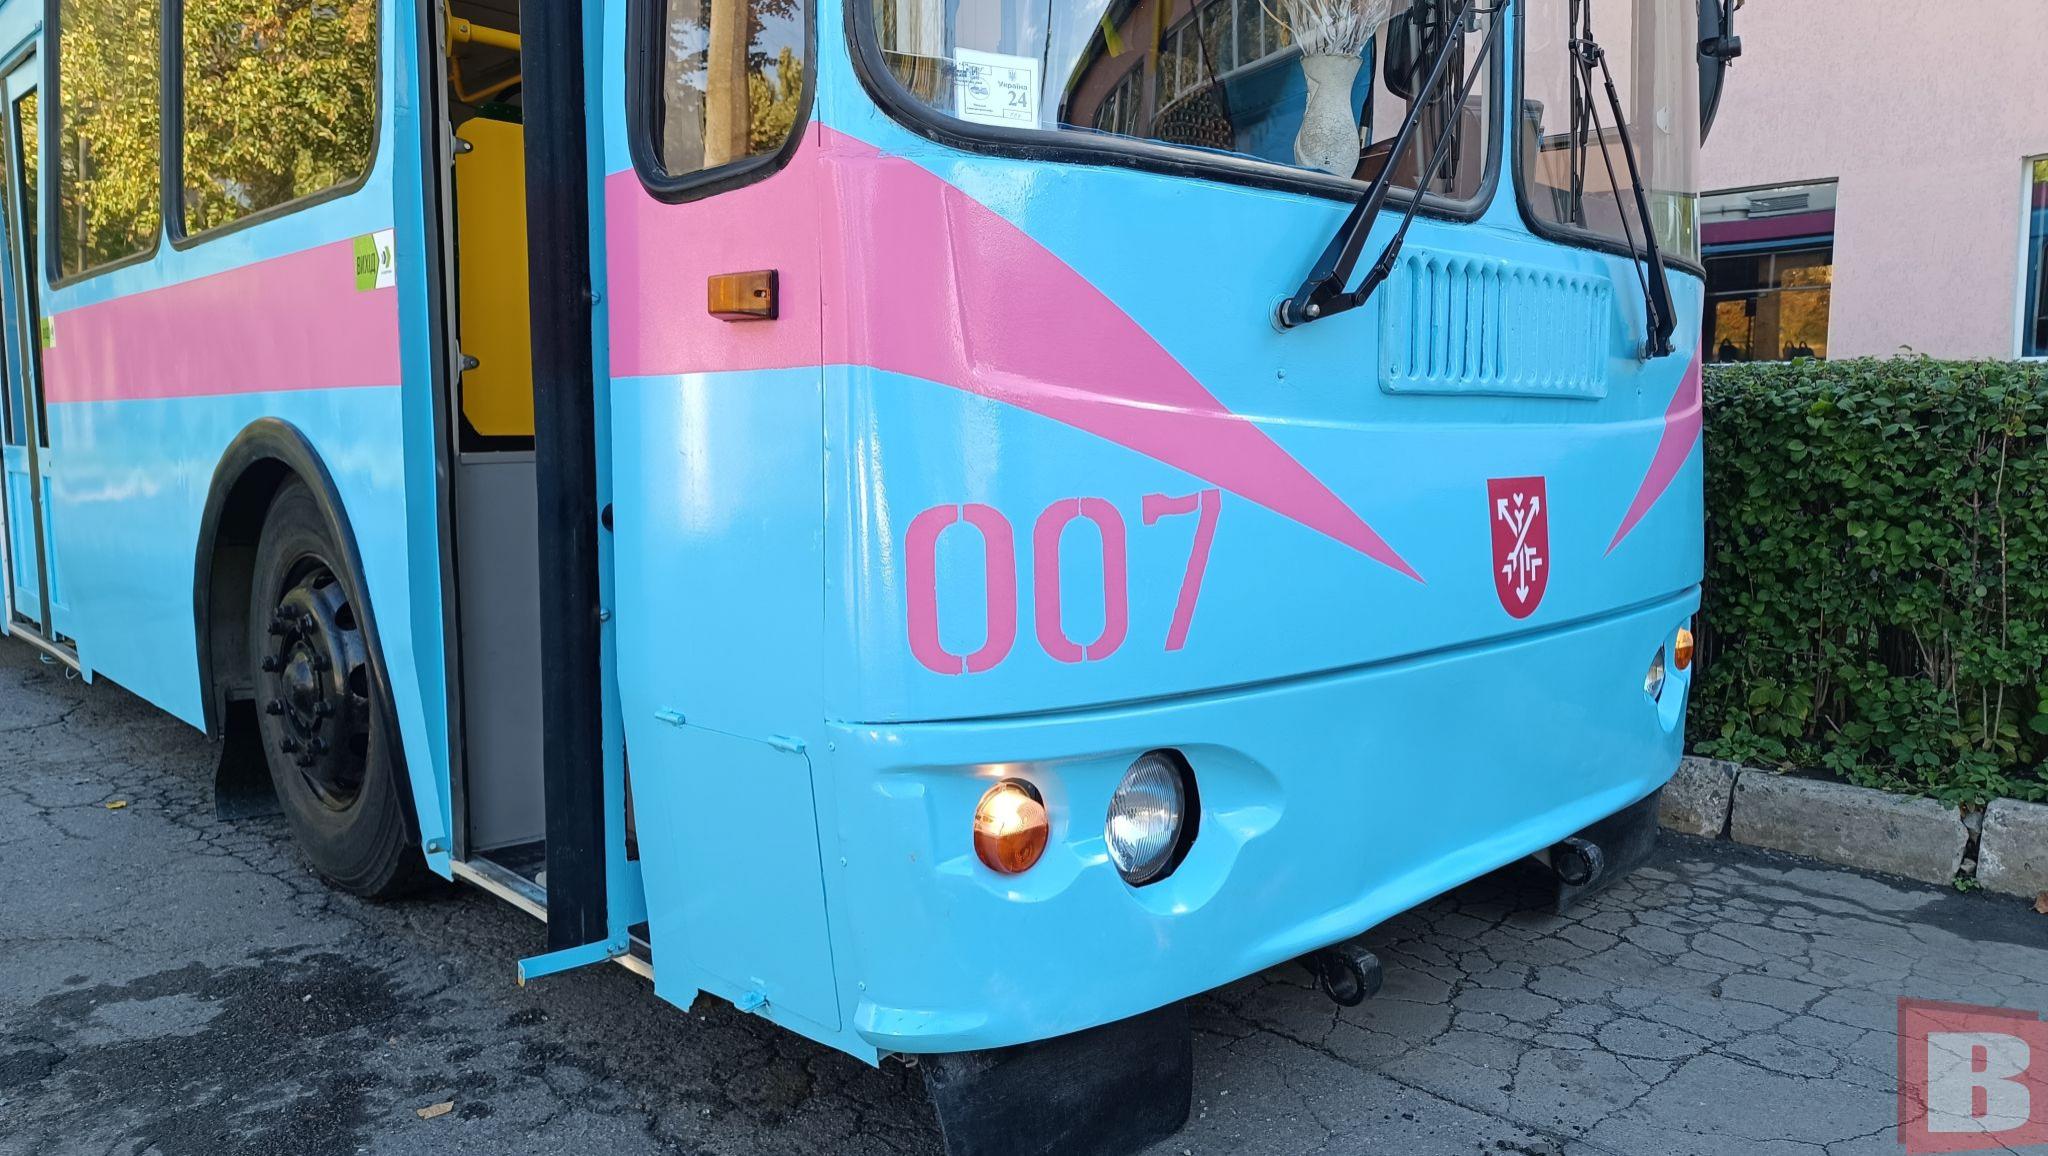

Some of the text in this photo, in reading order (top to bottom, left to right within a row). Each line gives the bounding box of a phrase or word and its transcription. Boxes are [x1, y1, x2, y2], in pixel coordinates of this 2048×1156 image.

[1008, 90, 1028, 107] 24
[356, 252, 376, 276] ВИХІД
[904, 488, 1222, 676] 007
